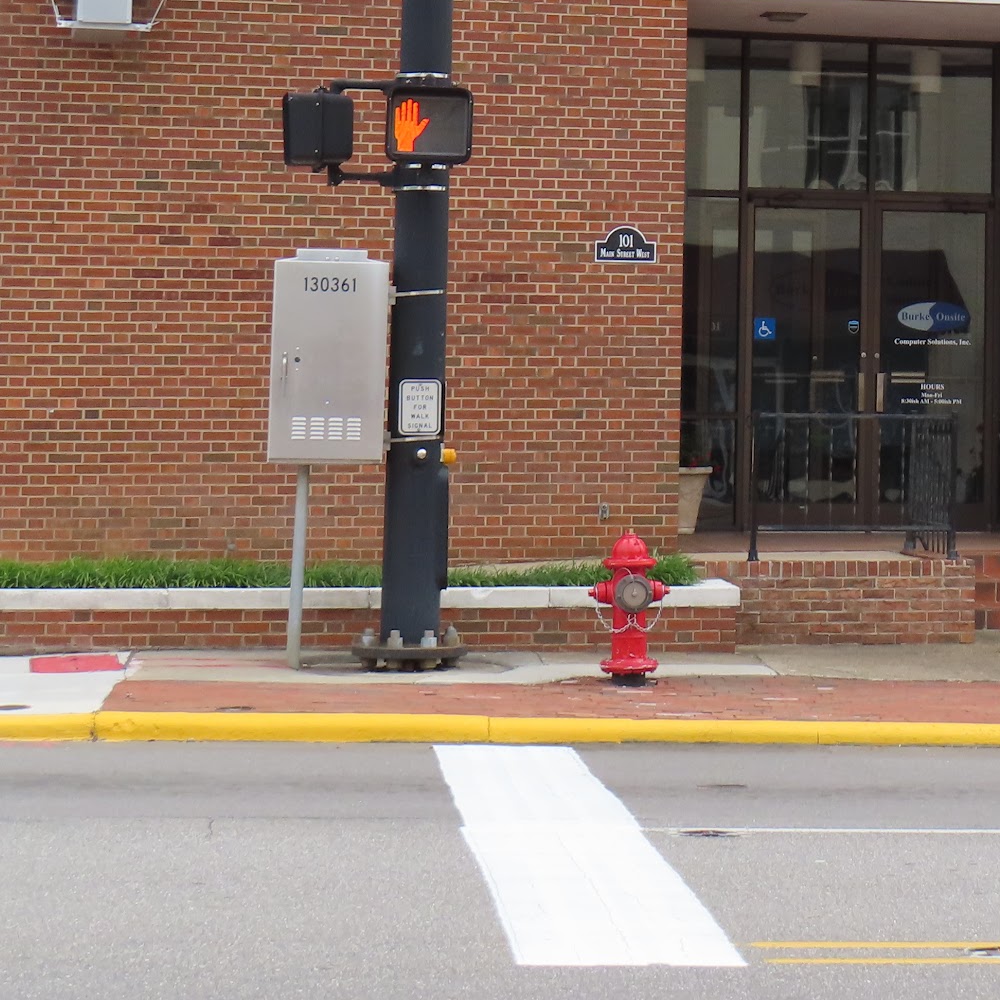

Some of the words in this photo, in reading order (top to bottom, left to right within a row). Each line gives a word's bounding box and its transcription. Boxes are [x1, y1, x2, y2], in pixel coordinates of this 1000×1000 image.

[619, 234, 634, 247] 101
[303, 276, 357, 293] 130361
[901, 312, 930, 321] Burke
[936, 312, 966, 321] Onsite
[894, 337, 926, 346] Computer
[927, 337, 958, 346] Solutions,
[959, 338, 971, 346] Inc.
